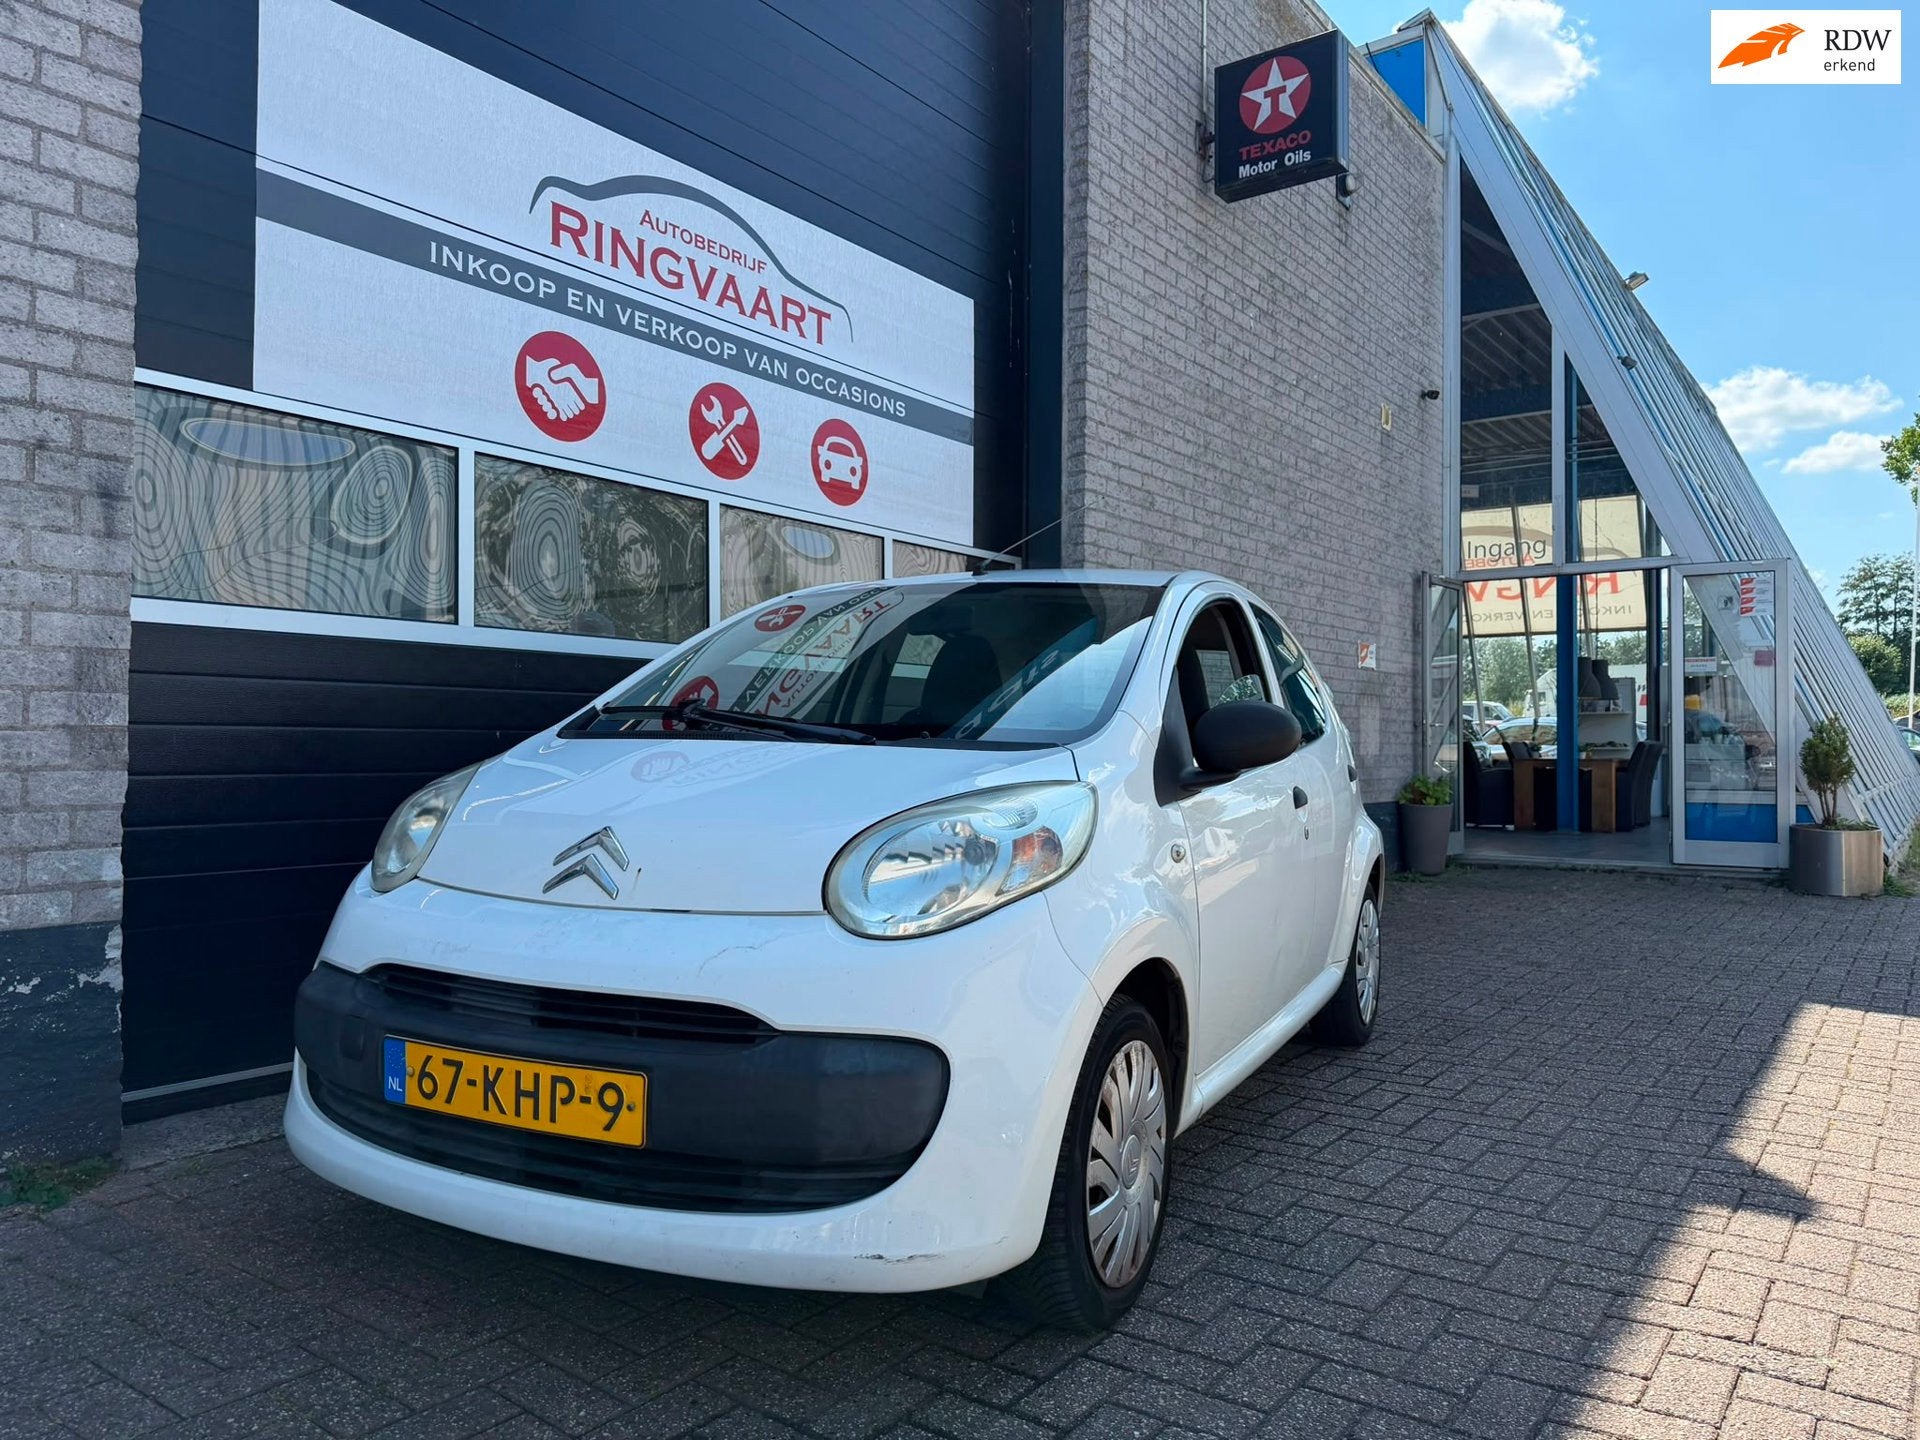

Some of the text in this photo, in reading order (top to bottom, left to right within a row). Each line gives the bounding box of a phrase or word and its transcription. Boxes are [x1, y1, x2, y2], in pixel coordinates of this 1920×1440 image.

[1238, 149, 1311, 179] Motor Oils
[1239, 130, 1312, 160] TEXACO
[639, 209, 768, 275] AUTOBEDRIJF
[549, 200, 831, 346] RINGVAART
[429, 241, 907, 418] INKOOP EN VERKOOP VAN OCCASIONS
[1467, 539, 1547, 562] Ingang
[388, 1075, 403, 1092] NL
[416, 1054, 626, 1132] 67-KHP-9
